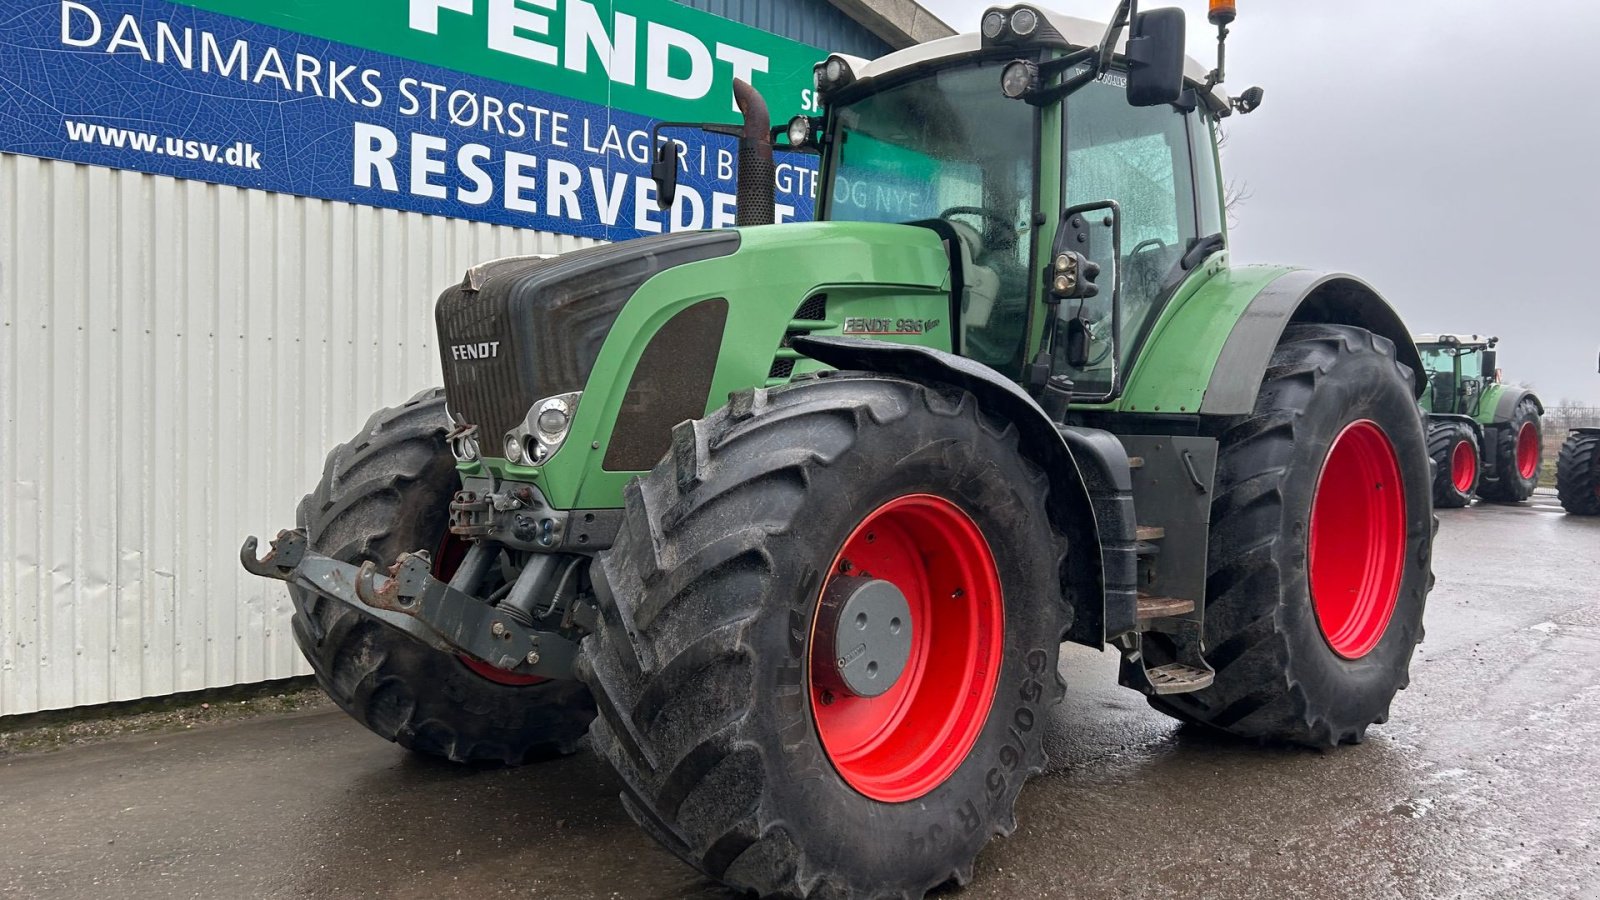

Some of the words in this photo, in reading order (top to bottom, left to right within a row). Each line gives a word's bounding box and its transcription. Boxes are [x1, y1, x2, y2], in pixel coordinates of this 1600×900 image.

[60, 0, 383, 108] DANMARKS
[399, 77, 569, 148] STØRSTE
[700, 144, 706, 176] I
[718, 149, 819, 199] BGTE
[833, 175, 867, 209] OG
[65, 120, 262, 170] www.usv.dk
[843, 317, 891, 332] FENDT
[896, 318, 923, 332] 936
[451, 340, 499, 361] FENDT
[985, 648, 1047, 802] 650/65
[957, 798, 982, 834] R
